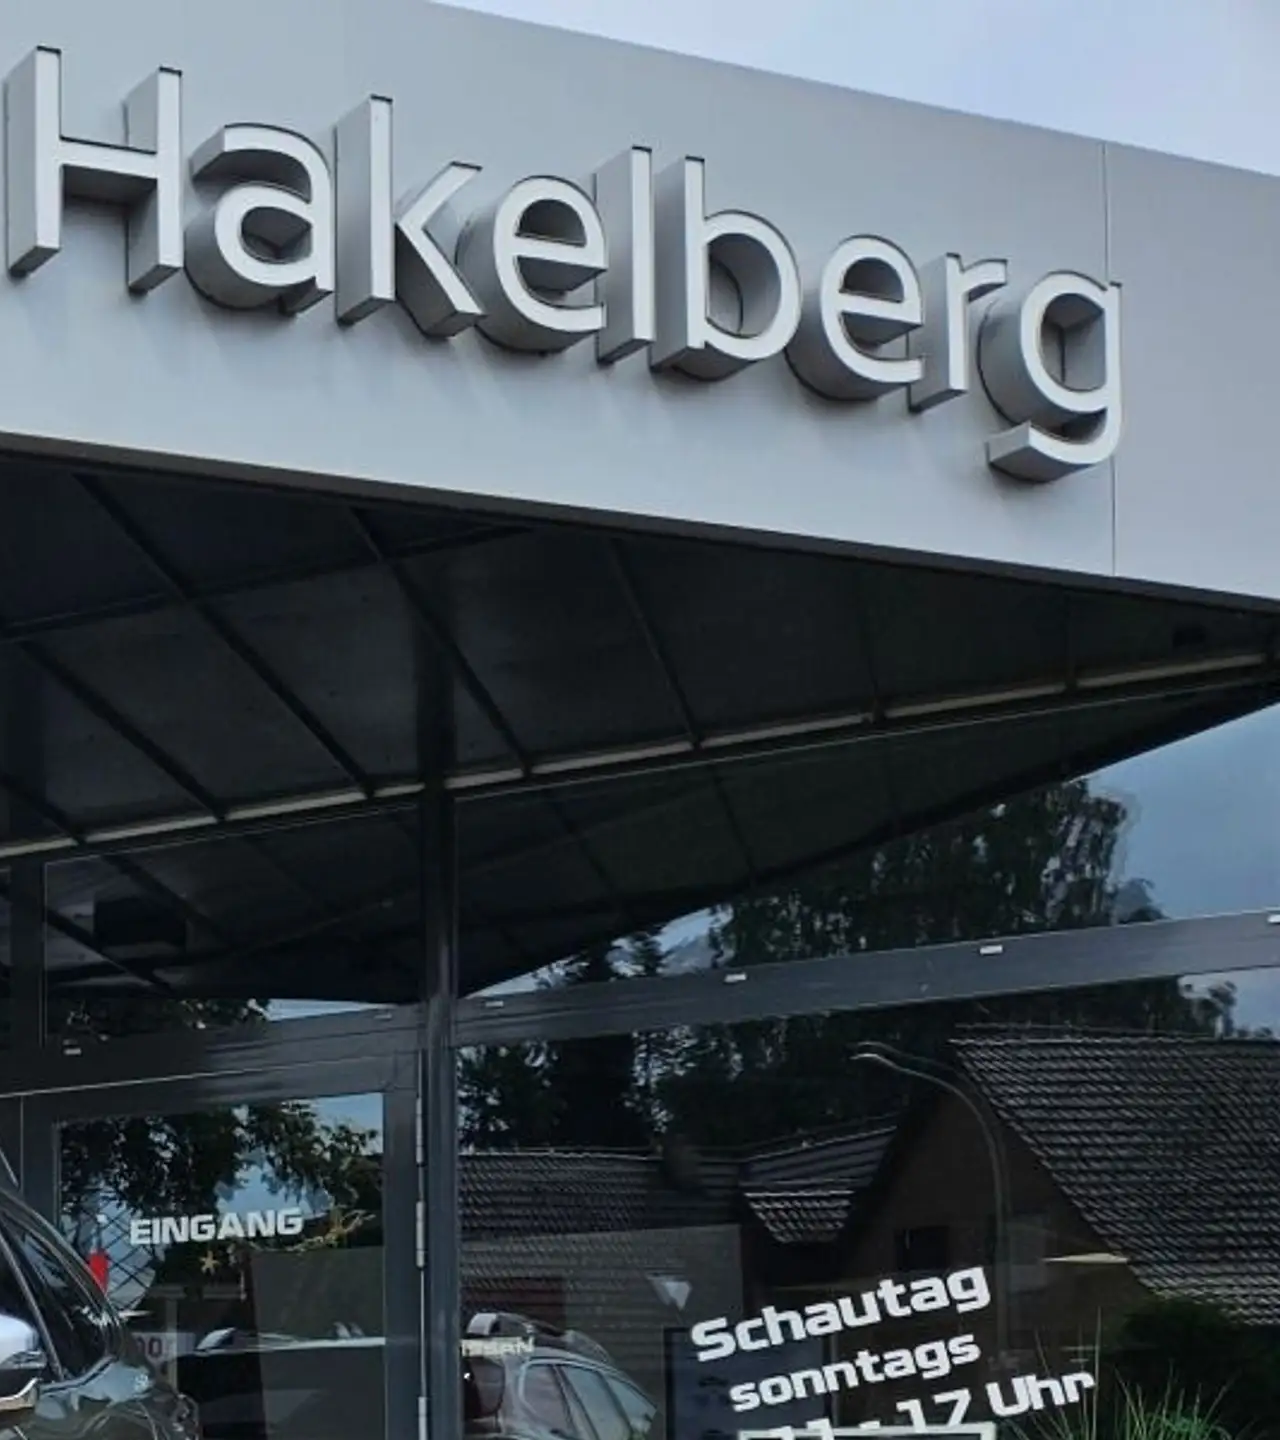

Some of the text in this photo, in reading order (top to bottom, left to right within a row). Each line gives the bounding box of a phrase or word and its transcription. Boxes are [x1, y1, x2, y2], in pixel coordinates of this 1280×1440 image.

[5, 46, 1123, 482] Hakelberg
[130, 1207, 303, 1245] EINGANG
[691, 1266, 992, 1361] Schautag
[730, 1333, 981, 1412] sonntags
[896, 1388, 972, 1433] 17
[986, 1369, 1096, 1417] Uhr
